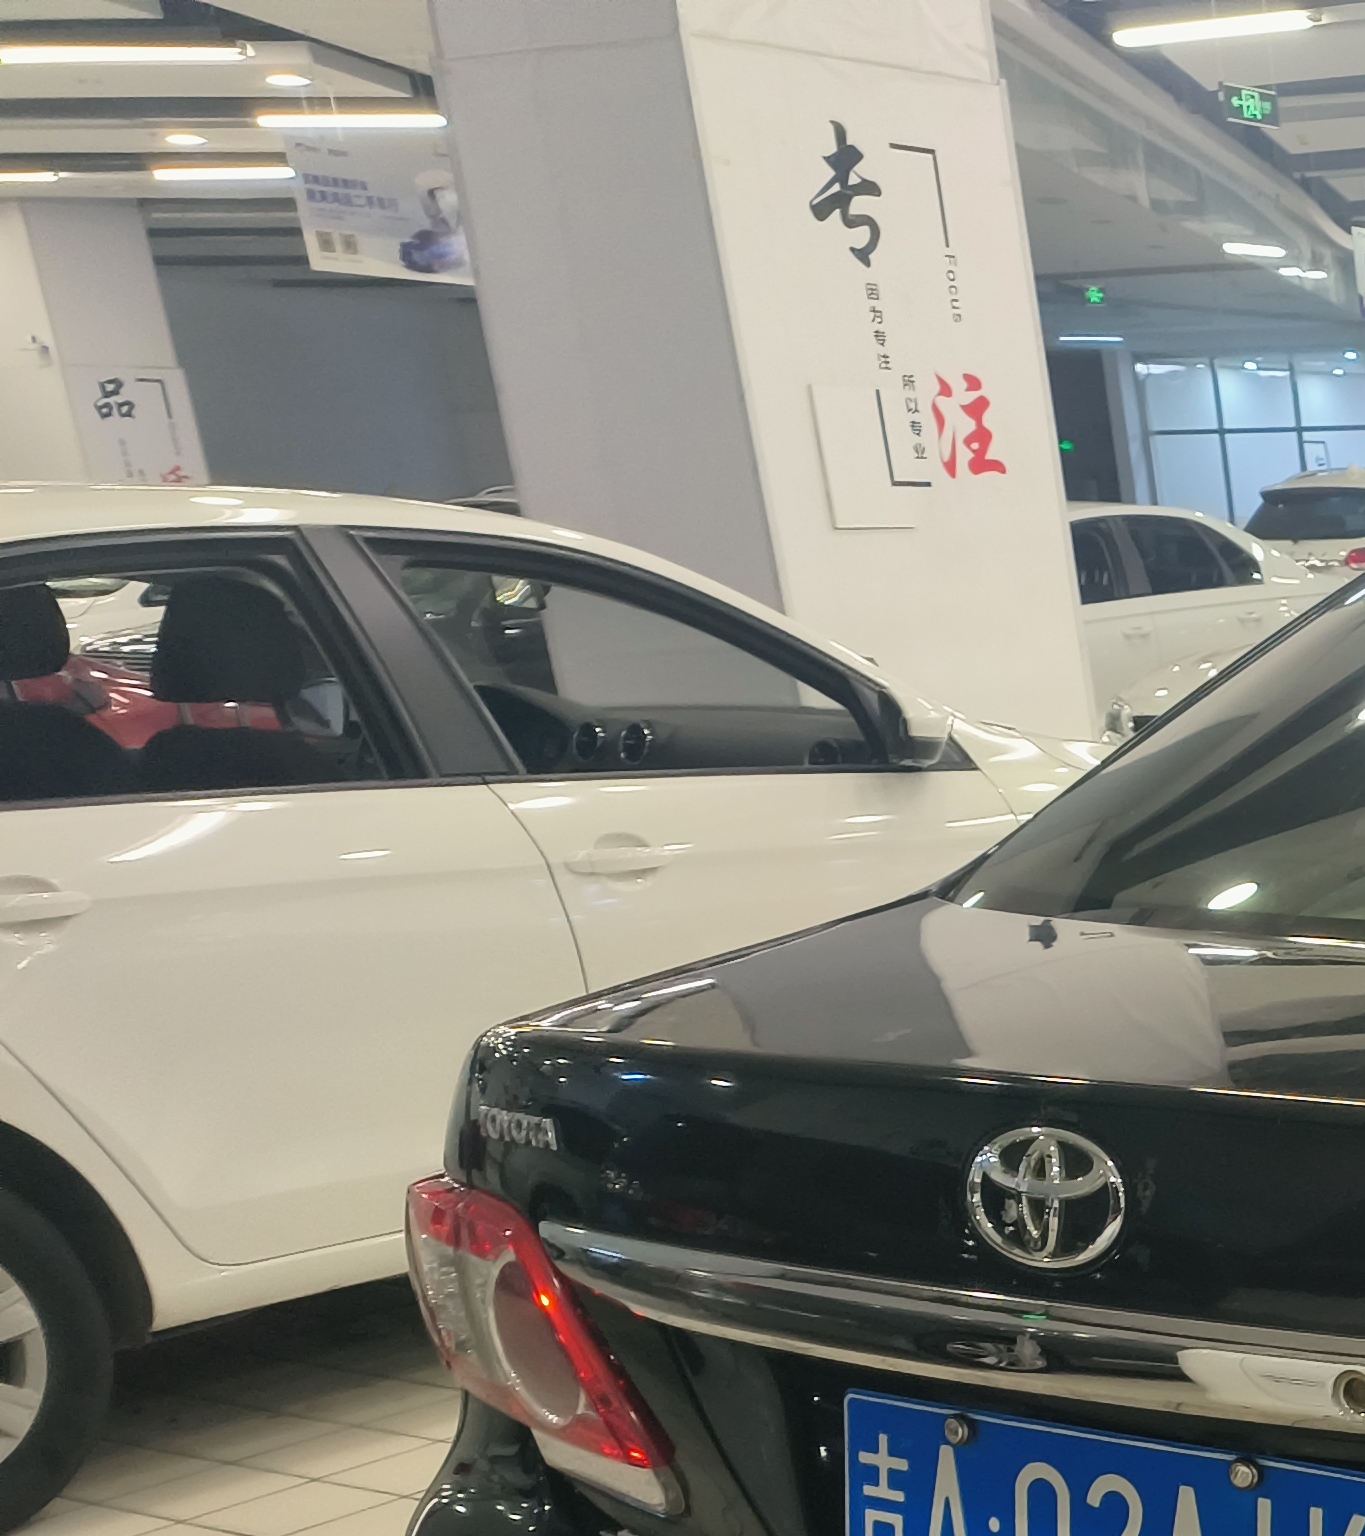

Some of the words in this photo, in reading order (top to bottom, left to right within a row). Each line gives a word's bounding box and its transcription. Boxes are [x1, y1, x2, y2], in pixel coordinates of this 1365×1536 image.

[809, 120, 882, 268] 专
[865, 282, 892, 371] 因为专注
[93, 377, 136, 420] 品
[901, 374, 928, 460] 所以专业
[931, 370, 1007, 479] 注
[479, 1105, 557, 1151] TOYOTA
